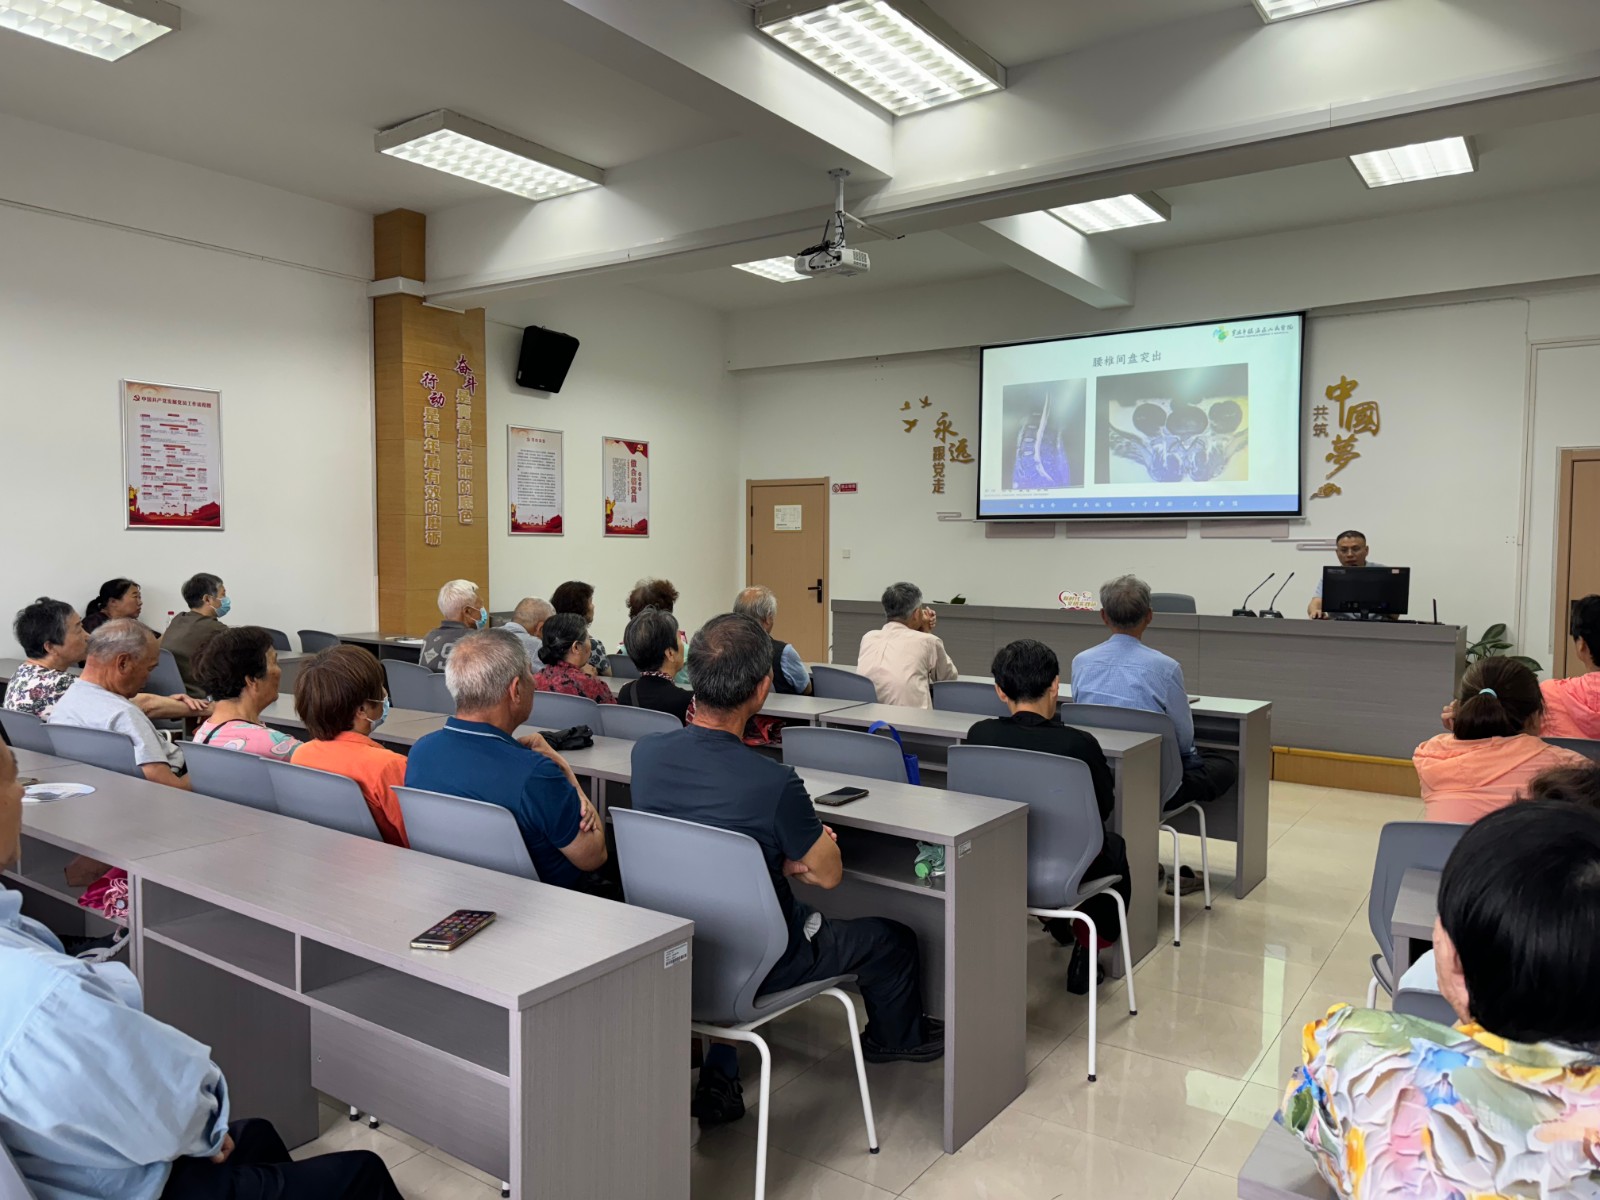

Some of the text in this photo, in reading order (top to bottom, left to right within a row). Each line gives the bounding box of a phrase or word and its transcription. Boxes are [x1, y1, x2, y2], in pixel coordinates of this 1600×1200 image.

[1092, 350, 1162, 367] 腰椎间盘突出
[1312, 404, 1329, 438] 共筑
[932, 445, 946, 495] 跟党走
